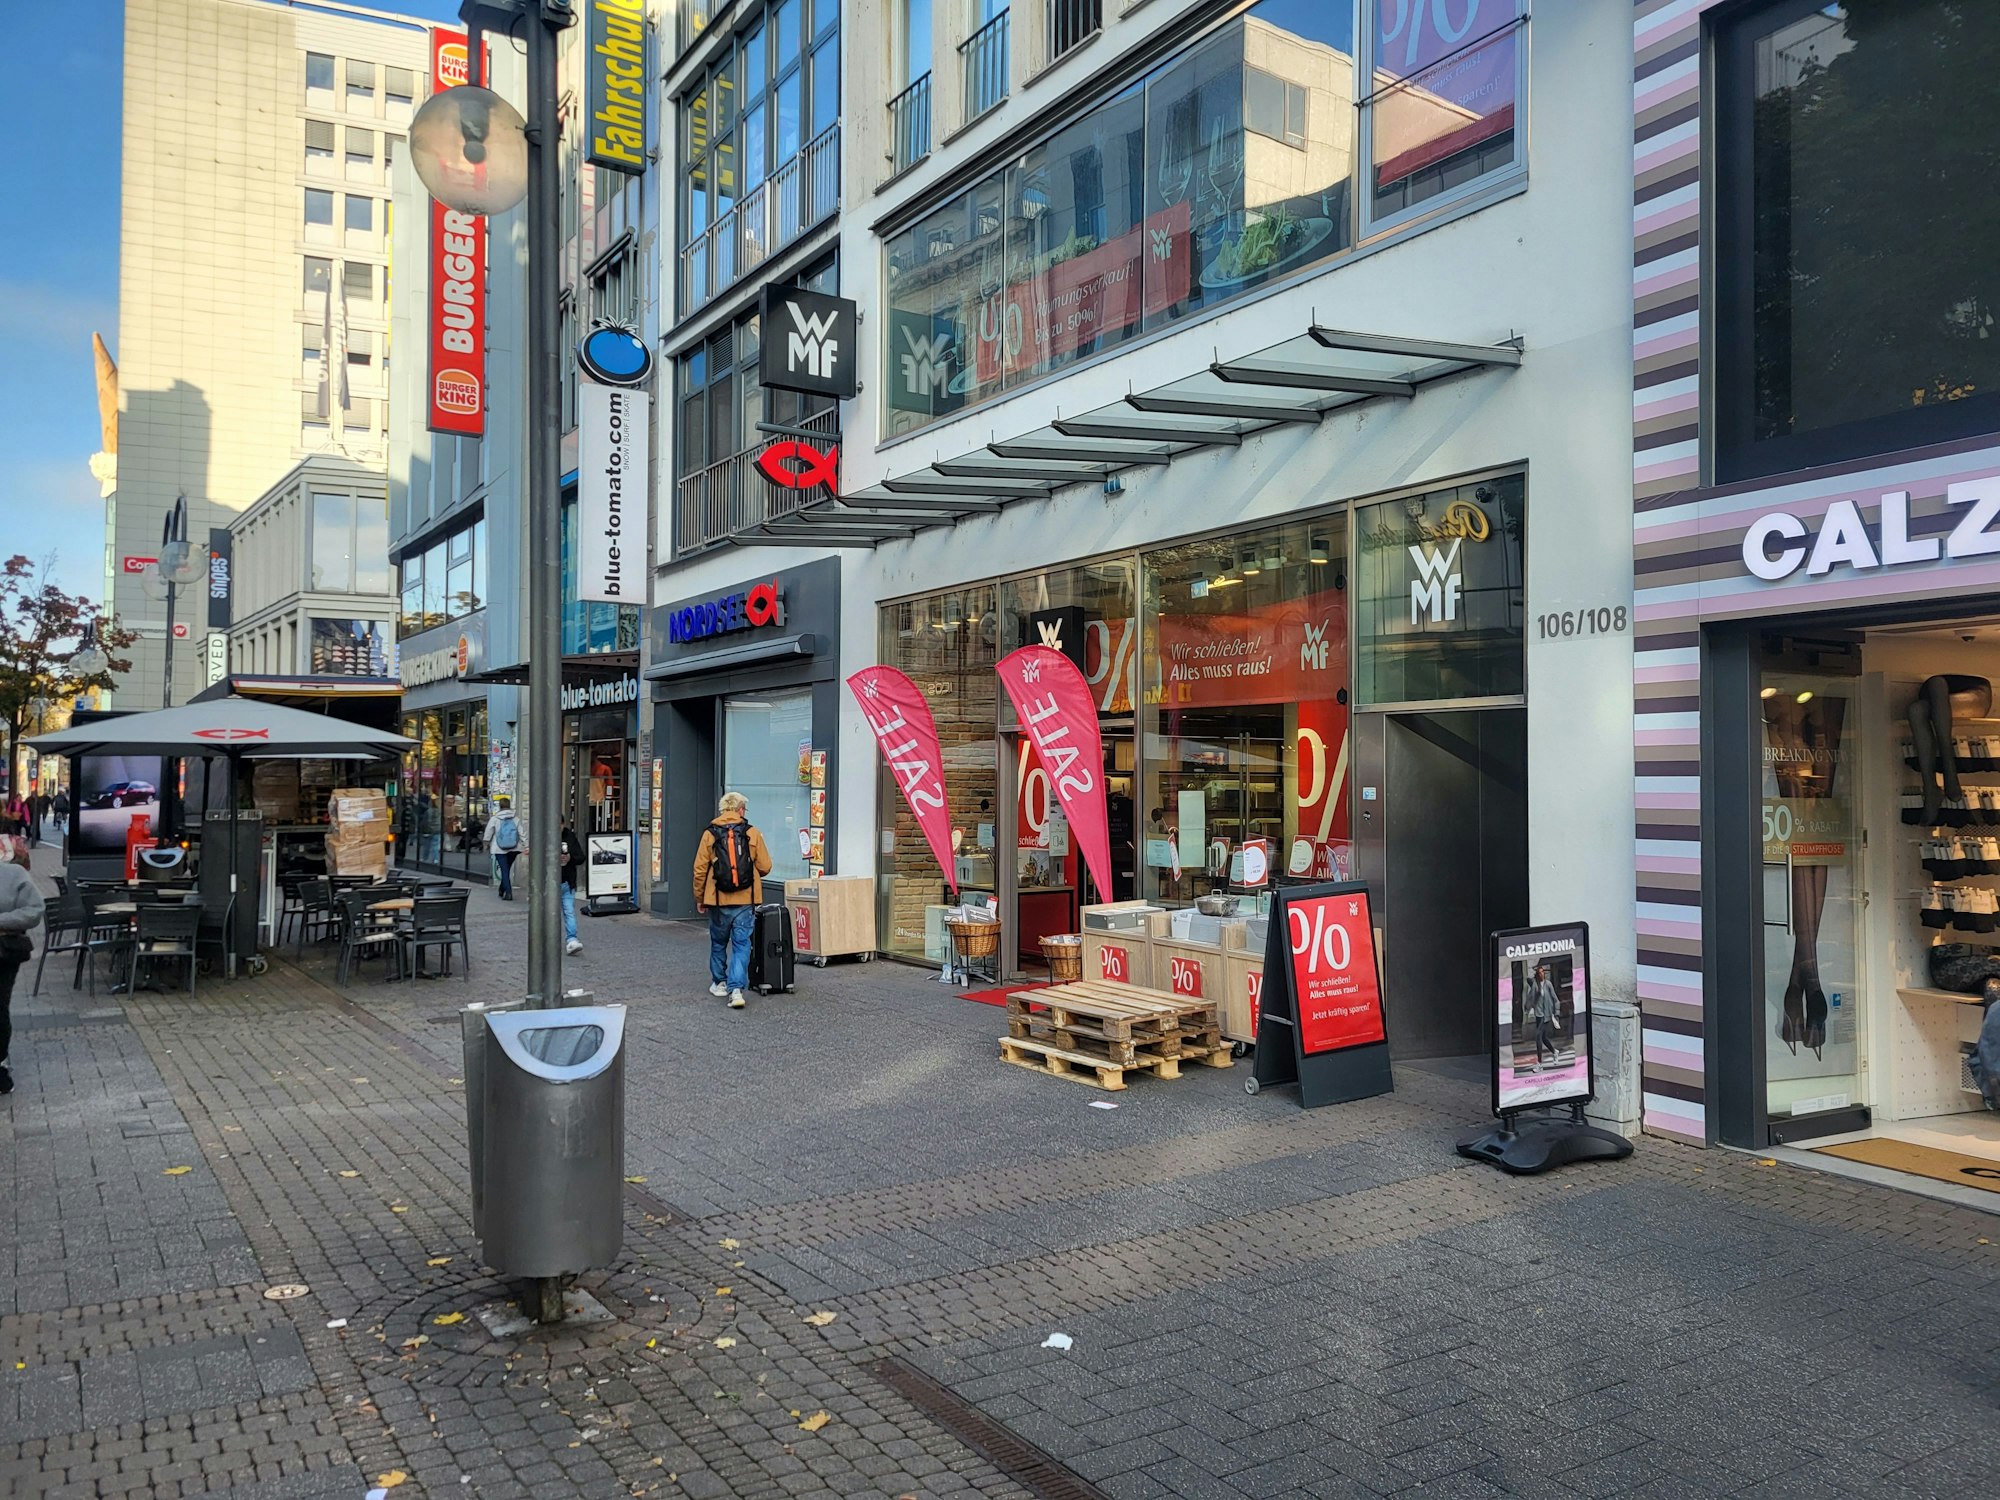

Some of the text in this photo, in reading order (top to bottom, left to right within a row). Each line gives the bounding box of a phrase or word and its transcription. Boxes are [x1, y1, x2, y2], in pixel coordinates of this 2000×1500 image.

[441, 56, 469, 68] BURG
[441, 65, 469, 79] KIN
[443, 209, 475, 354] BURGER
[785, 301, 839, 379] WMF
[1052, 322, 1063, 338] zu
[438, 381, 477, 394] BURGER
[438, 391, 477, 405] KING
[604, 392, 622, 596] blue-tomato.com
[1743, 475, 2000, 580] CALZ
[211, 557, 231, 599] snipes
[1408, 538, 1462, 625] WMF
[669, 592, 746, 644] NORDSEE
[1537, 605, 1627, 639] 106/108
[1171, 636, 1261, 661] Wir schließen!
[1301, 618, 1329, 670] WMF
[212, 639, 224, 682] RVED
[1170, 656, 1272, 681] Alles muss raus!
[560, 672, 638, 710] blue-tomato
[1764, 747, 1824, 763] BREAKING
[1763, 804, 1792, 842] 50
[1506, 938, 1577, 959] CALZEDONIA
[1308, 974, 1351, 990] Wir schließen!
[1309, 984, 1359, 1000] Alles muss raus!
[1312, 1011, 1328, 1021] Jetzt
[1328, 1007, 1349, 1017] kräftig
